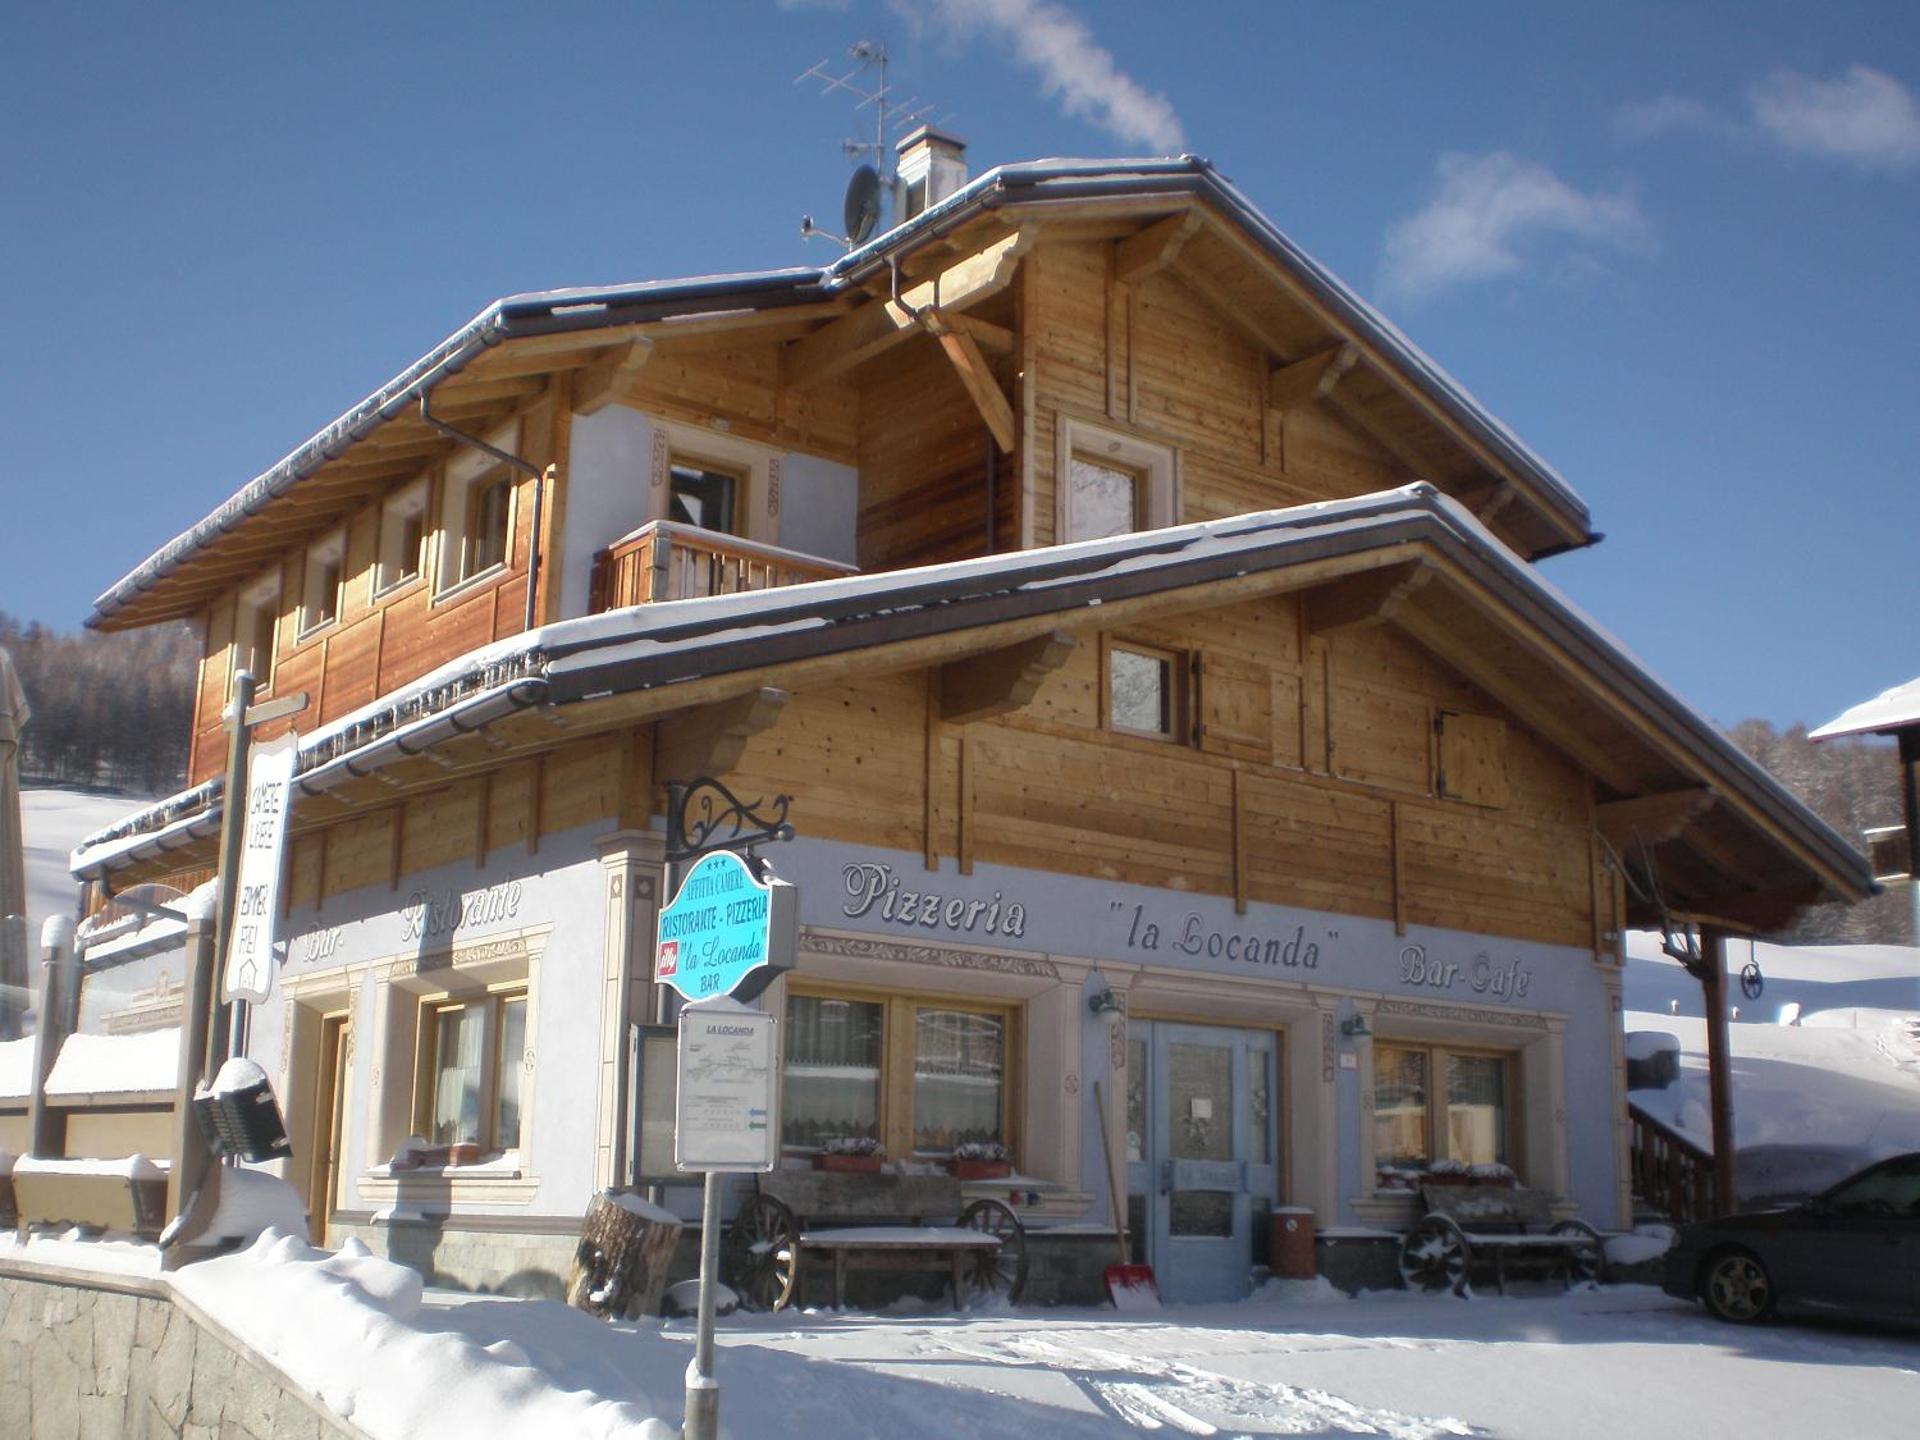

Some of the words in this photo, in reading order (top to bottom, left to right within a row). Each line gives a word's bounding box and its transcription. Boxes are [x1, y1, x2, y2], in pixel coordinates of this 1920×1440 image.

[716, 868, 744, 894] CAMERE
[401, 874, 522, 942] Ristorante
[842, 863, 1025, 938] Pizzeria
[662, 906, 717, 939] RISTORANTE
[726, 894, 768, 927] PIZZERIA
[659, 946, 677, 971] illy
[700, 973, 720, 992] BAR
[706, 1025, 717, 1034] LA
